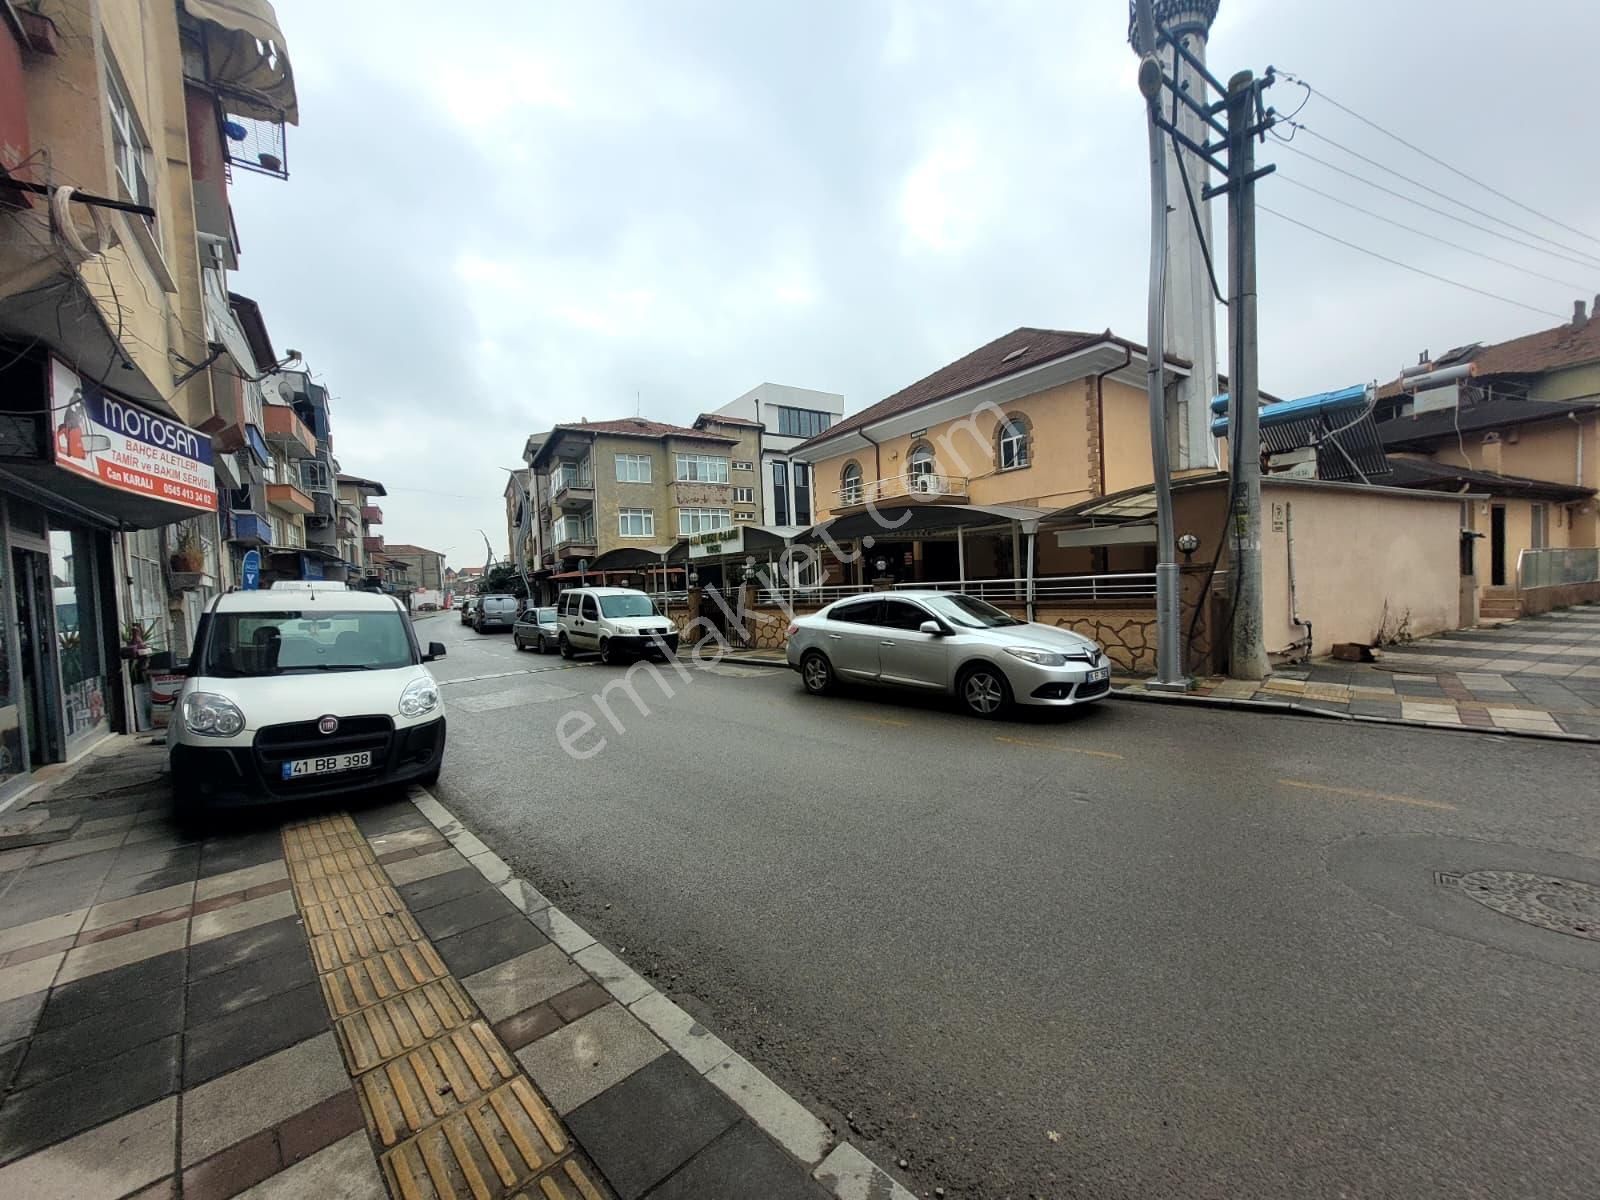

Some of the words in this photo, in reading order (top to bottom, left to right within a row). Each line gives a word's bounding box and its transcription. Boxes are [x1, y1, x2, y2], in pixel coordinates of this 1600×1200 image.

[103, 397, 199, 459] MOTOSAN
[125, 440, 158, 460] BAHÇE
[107, 467, 122, 479] Can
[142, 464, 151, 472] ve
[154, 464, 180, 481] BAKIM
[294, 761, 308, 773] 41
[315, 758, 336, 771] BB
[344, 753, 369, 767] 398
